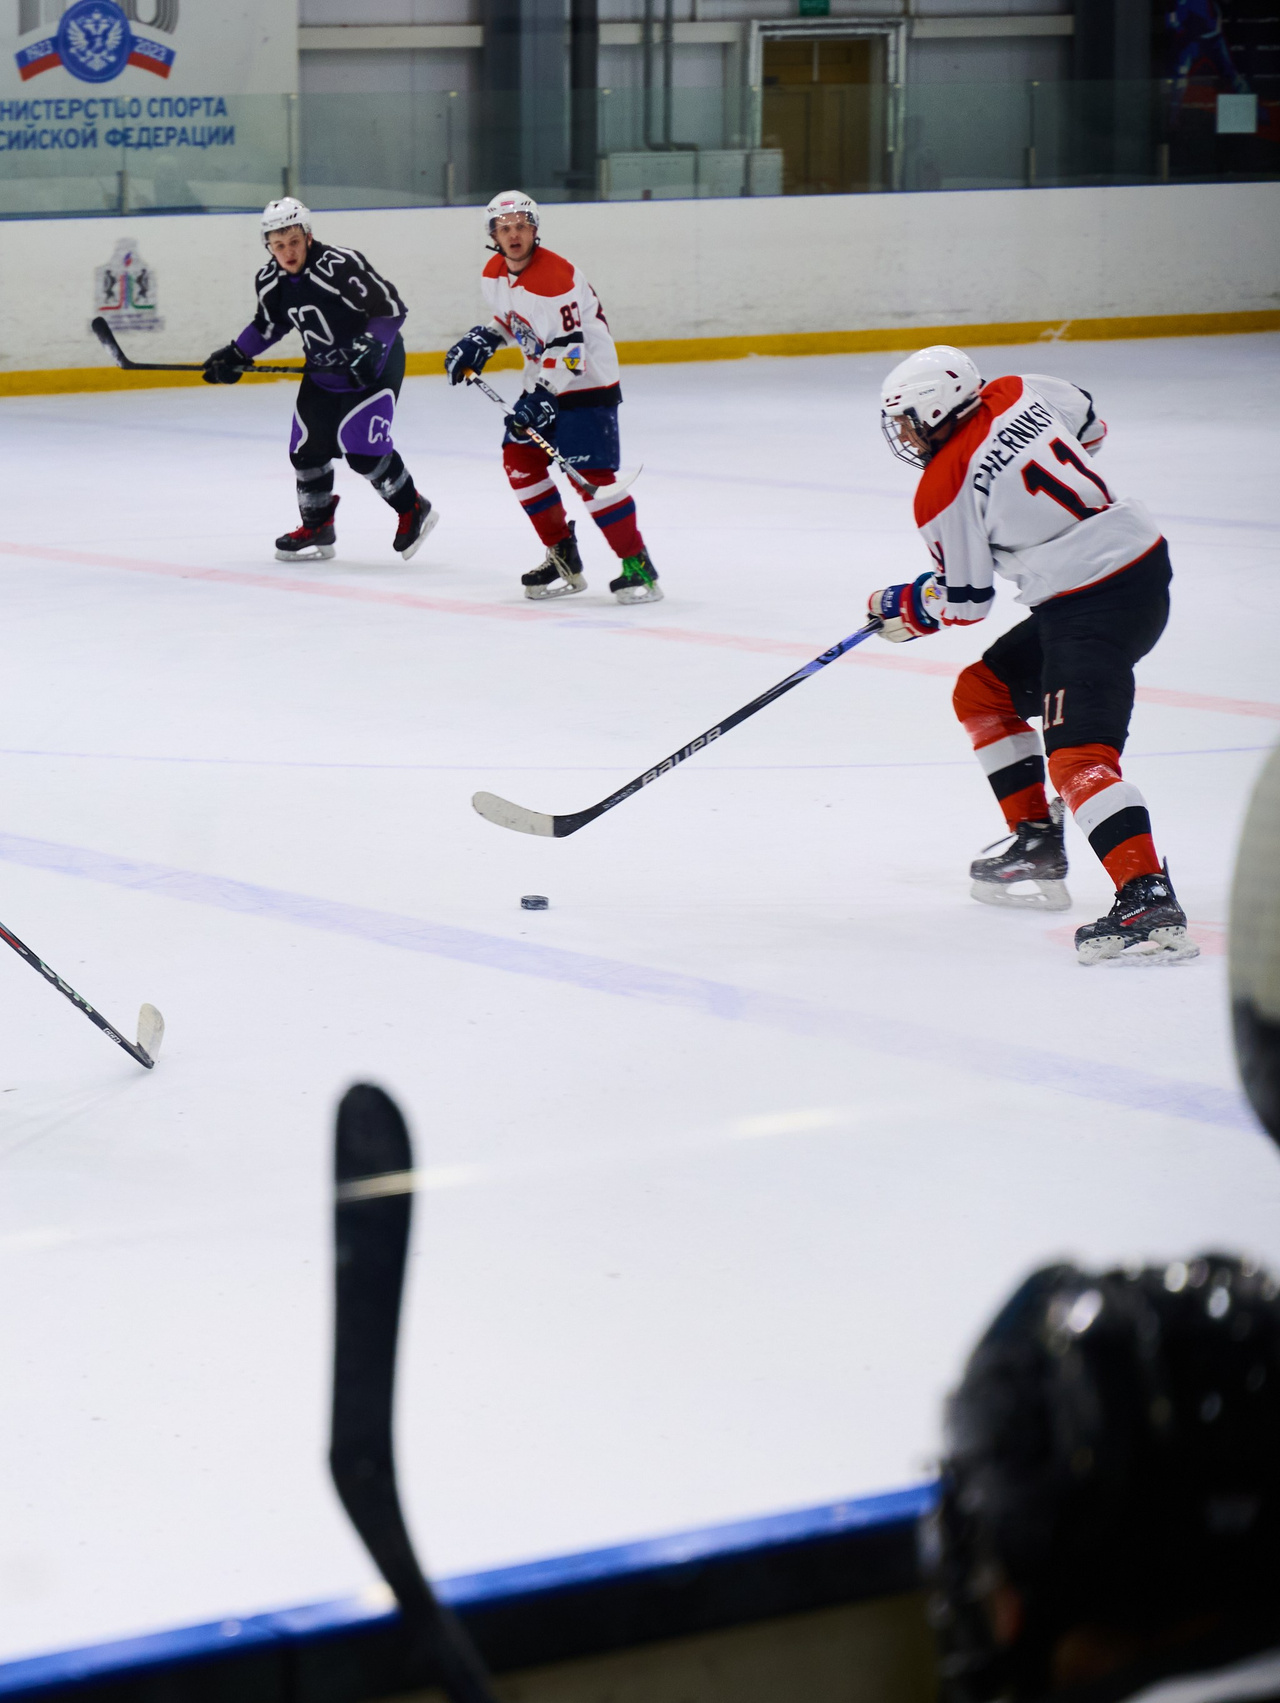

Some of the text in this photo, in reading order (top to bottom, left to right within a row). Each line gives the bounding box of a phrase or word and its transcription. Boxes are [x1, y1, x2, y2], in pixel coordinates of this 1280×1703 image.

[134, 38, 168, 62] 2023
[147, 96, 228, 118] СПОРТА
[104, 125, 236, 150] ФЕДЕРАЦИИ
[348, 275, 369, 298] 3
[1021, 437, 1114, 521] 11
[1043, 688, 1066, 731] 11
